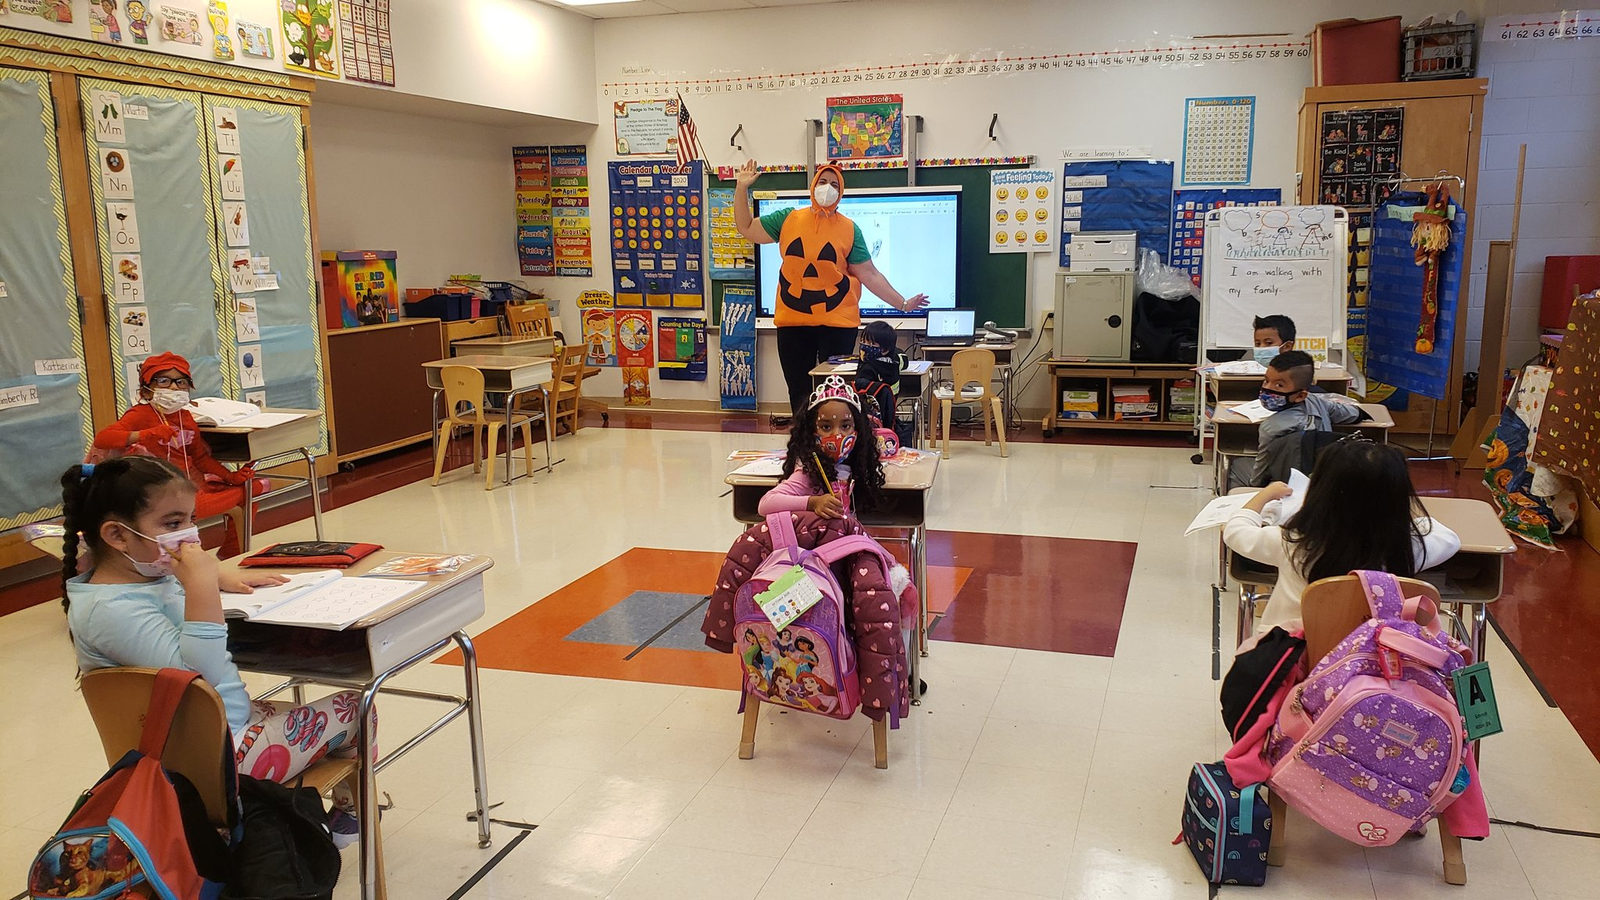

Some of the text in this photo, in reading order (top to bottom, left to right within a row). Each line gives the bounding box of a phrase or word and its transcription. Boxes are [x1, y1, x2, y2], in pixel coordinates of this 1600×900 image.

[1502, 31, 1511, 39] 61
[1516, 30, 1528, 38] 62
[1533, 29, 1545, 38] 63
[1582, 26, 1592, 34] 66
[843, 75, 851, 83] 23
[854, 74, 862, 82] 24
[888, 71, 896, 79] 27
[899, 70, 908, 78] 28
[979, 65, 989, 73] 35
[1015, 63, 1025, 71] 38
[1063, 60, 1073, 68] 42
[1076, 59, 1085, 67] 43
[1088, 58, 1098, 66] 44
[1139, 55, 1149, 63] 48
[1152, 54, 1162, 62] 49
[1165, 54, 1175, 62] 50
[1189, 53, 1199, 61] 52
[1215, 52, 1226, 60] 54
[1256, 50, 1267, 58] 57
[1283, 49, 1294, 57] 59
[1297, 49, 1308, 57] 60
[98, 120, 122, 135] Mm
[222, 133, 235, 146] Tt
[1062, 150, 1073, 158] We
[1094, 150, 1115, 158] learning
[619, 165, 652, 175] Calendar
[661, 165, 692, 174] Weaer
[1006, 173, 1032, 181] Feeling
[109, 178, 128, 192] Nn
[227, 181, 241, 193] Uu
[116, 231, 135, 245] Oo
[232, 227, 244, 239] Vv
[526, 247, 545, 255] Friday
[1230, 266, 1238, 276] I
[1265, 267, 1293, 280] walking
[1301, 267, 1322, 276] with
[232, 274, 252, 286] Ww
[122, 283, 139, 301] Pp
[1229, 288, 1241, 297] my
[580, 298, 611, 306] Weather
[242, 323, 255, 335] Xx
[127, 335, 149, 352] Qq
[1292, 338, 1326, 349] ITCH
[42, 361, 79, 371] Katherine
[245, 370, 258, 385] Yy
[0, 390, 27, 404] mberly
[1470, 675, 1486, 706] A
